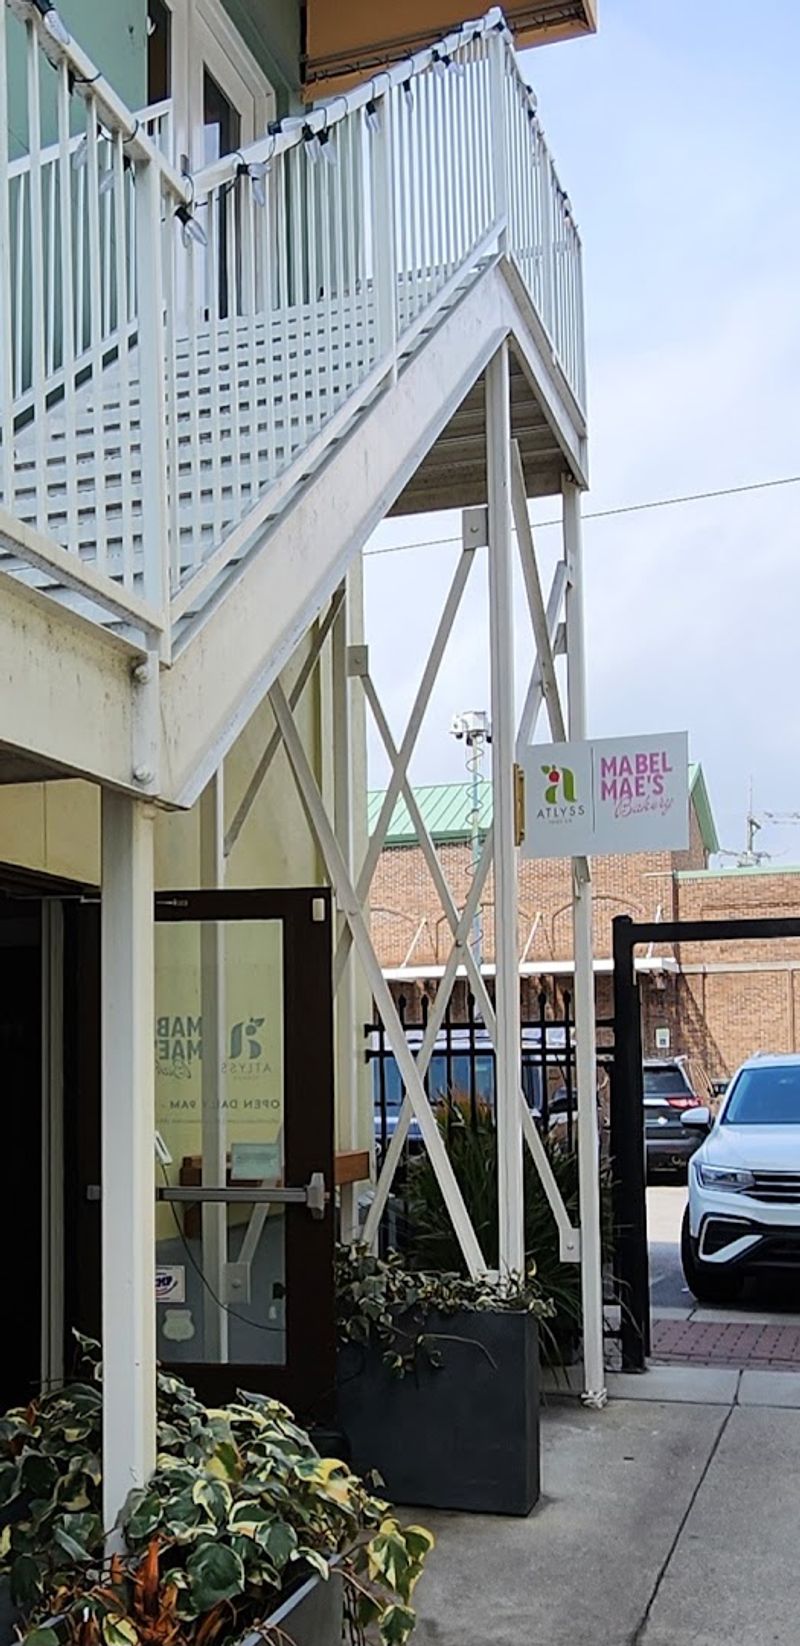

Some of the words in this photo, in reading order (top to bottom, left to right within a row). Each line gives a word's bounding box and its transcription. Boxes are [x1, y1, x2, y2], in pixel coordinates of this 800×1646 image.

[601, 752, 672, 778] MABEL
[601, 774, 664, 801] MAE'S
[537, 805, 585, 819] ATLYSS
[615, 796, 674, 818] Bakery
